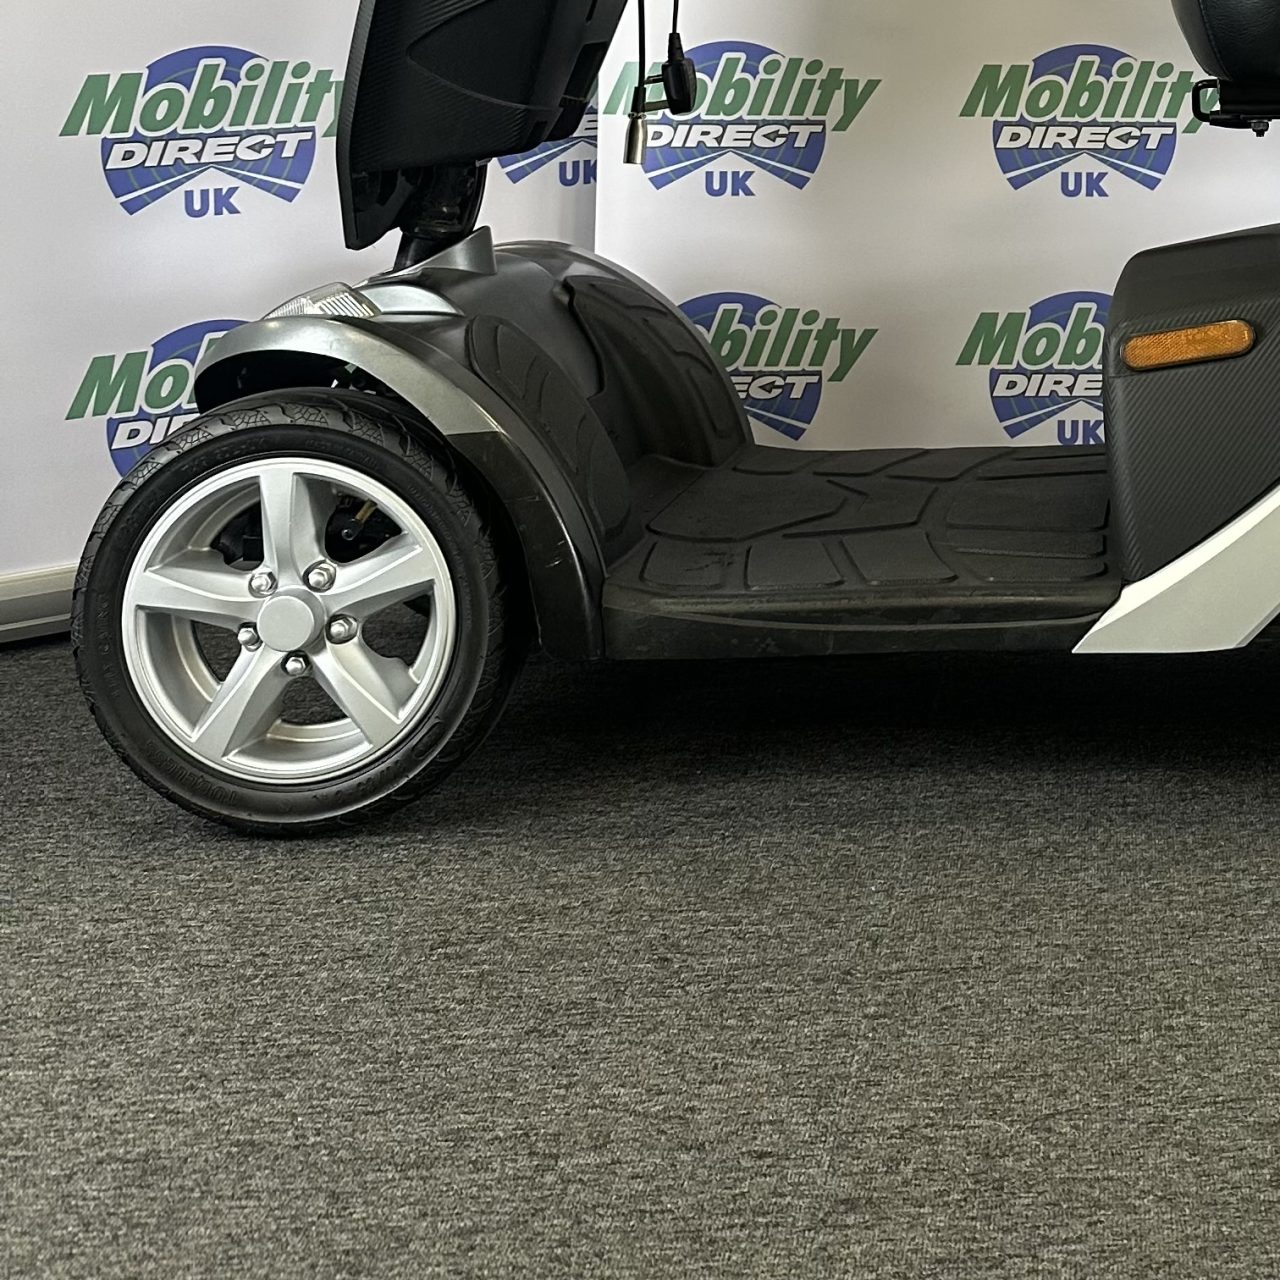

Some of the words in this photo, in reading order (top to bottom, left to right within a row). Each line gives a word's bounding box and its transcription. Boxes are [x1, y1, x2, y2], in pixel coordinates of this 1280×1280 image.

[646, 121, 823, 148] DIRECT
[996, 123, 1175, 150] DIRECT
[105, 132, 312, 169] DIRECT
[705, 171, 756, 196] UK
[1060, 172, 1109, 198] UK
[184, 187, 241, 218] UK
[710, 308, 879, 383] bility
[992, 373, 1103, 397] DIRE
[1057, 419, 1105, 445] UK
